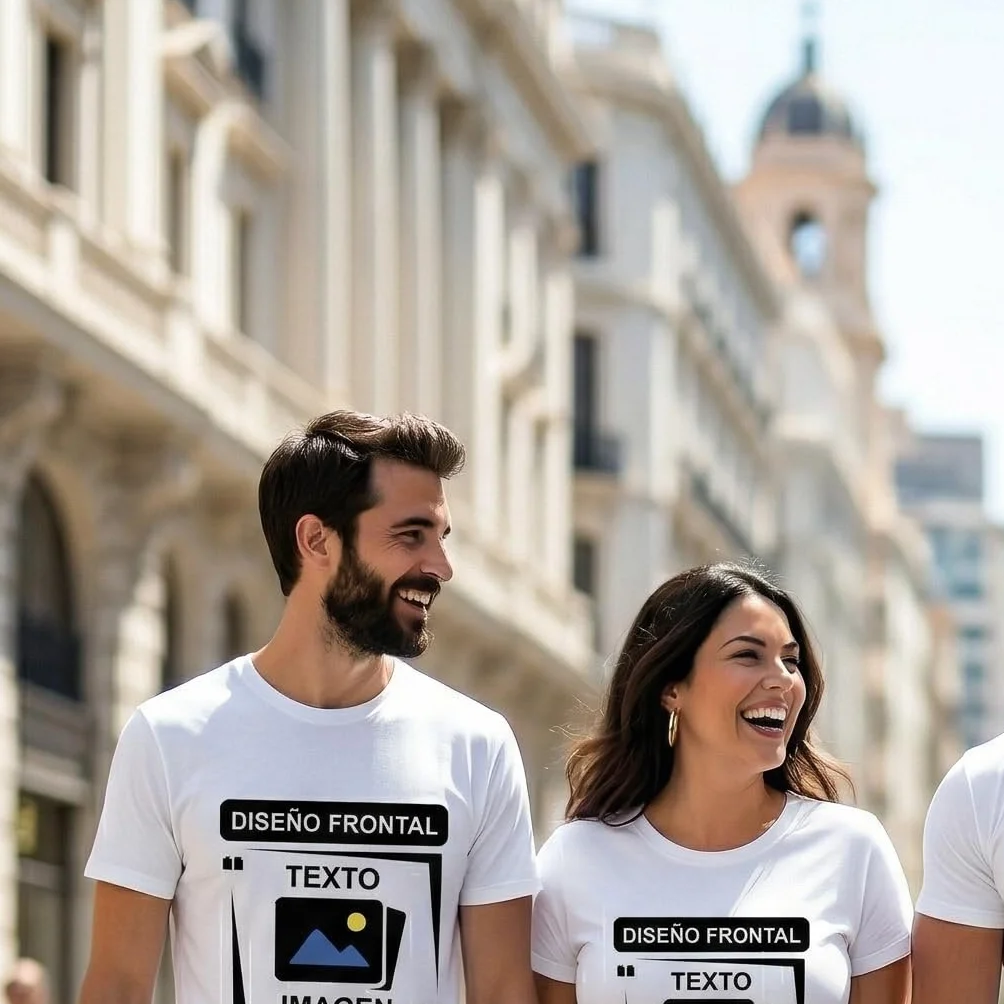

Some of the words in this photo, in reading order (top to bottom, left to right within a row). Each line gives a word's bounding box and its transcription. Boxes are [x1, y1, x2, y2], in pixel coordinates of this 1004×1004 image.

[231, 808, 320, 833] DISEÑO
[329, 814, 438, 836] FRONTAL
[286, 865, 380, 890] TEXTO
[623, 923, 701, 944] DISEÑO
[707, 927, 801, 944] FRONTAL
[671, 972, 752, 991] TEXTO
